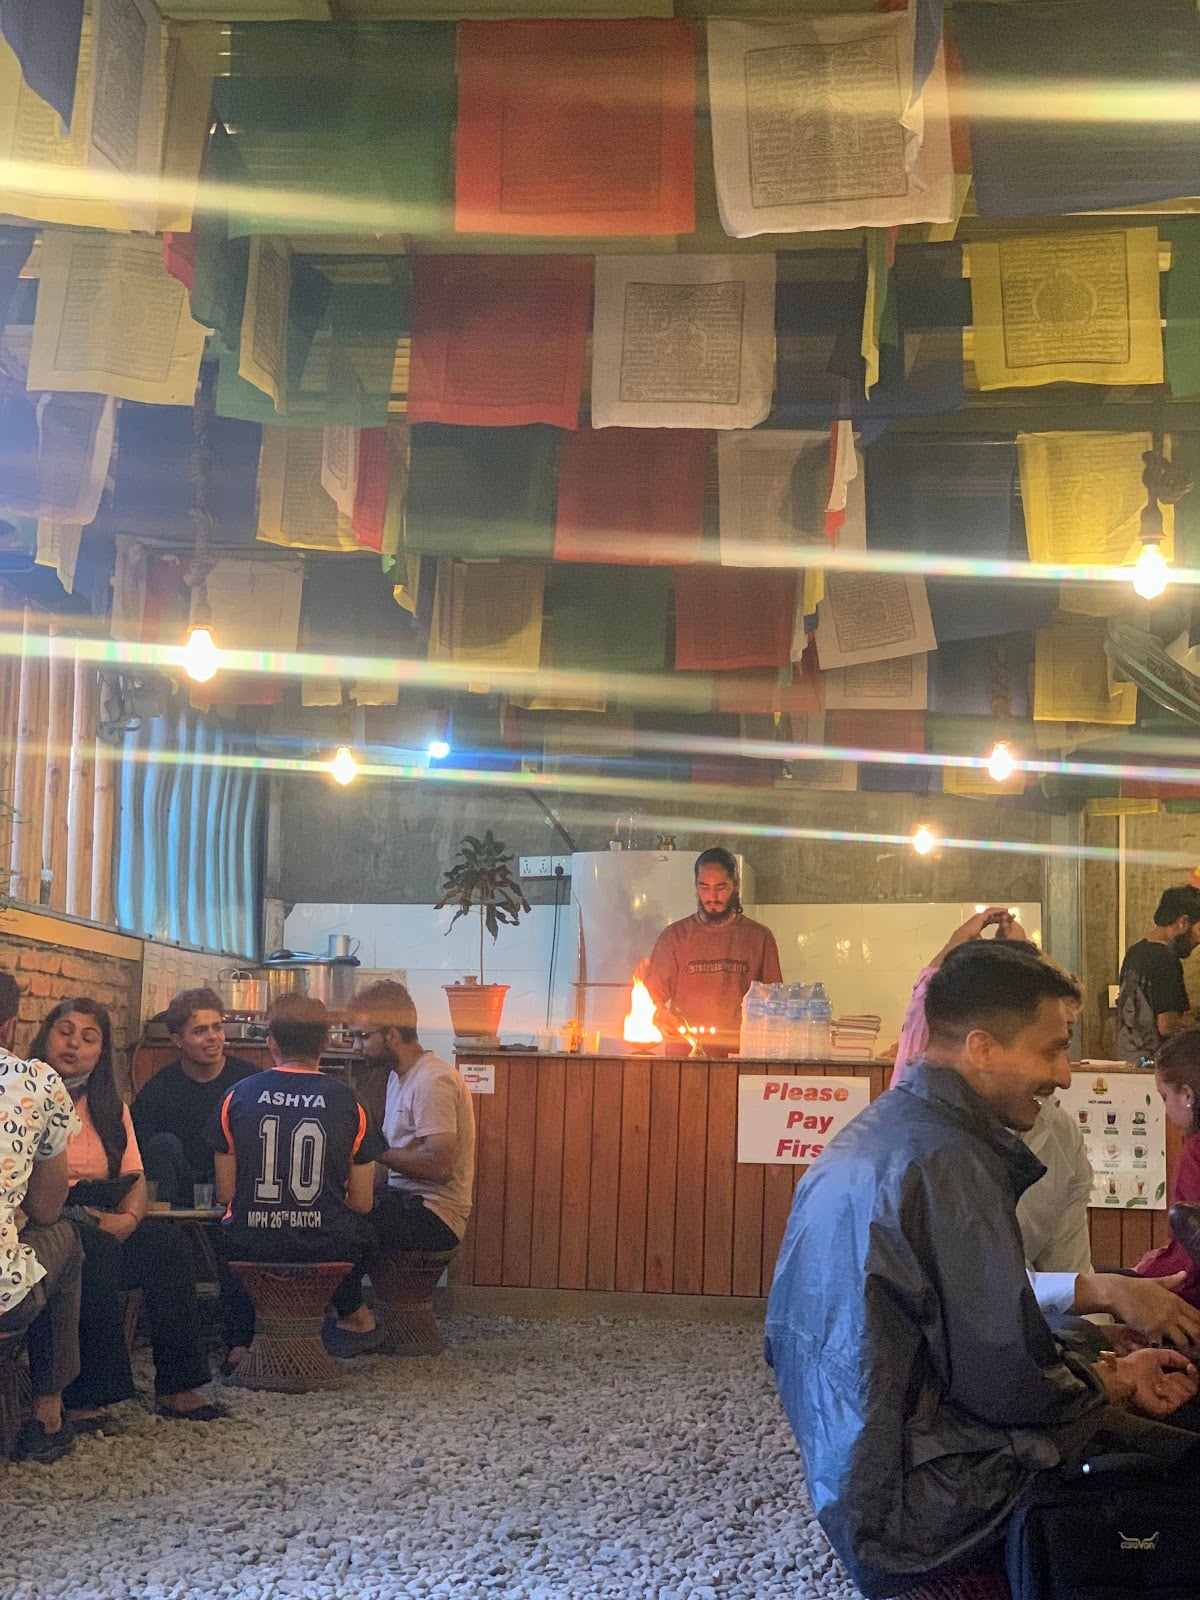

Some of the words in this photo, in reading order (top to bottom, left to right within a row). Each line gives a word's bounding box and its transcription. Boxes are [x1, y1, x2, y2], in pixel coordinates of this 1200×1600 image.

[257, 1090, 326, 1108] ASHYA
[763, 1082, 849, 1102] Please
[786, 1110, 834, 1134] Pay
[776, 1139, 825, 1158] Firs
[254, 1114, 327, 1206] 10
[247, 1211, 268, 1227] MPH
[290, 1211, 321, 1228] BATCH
